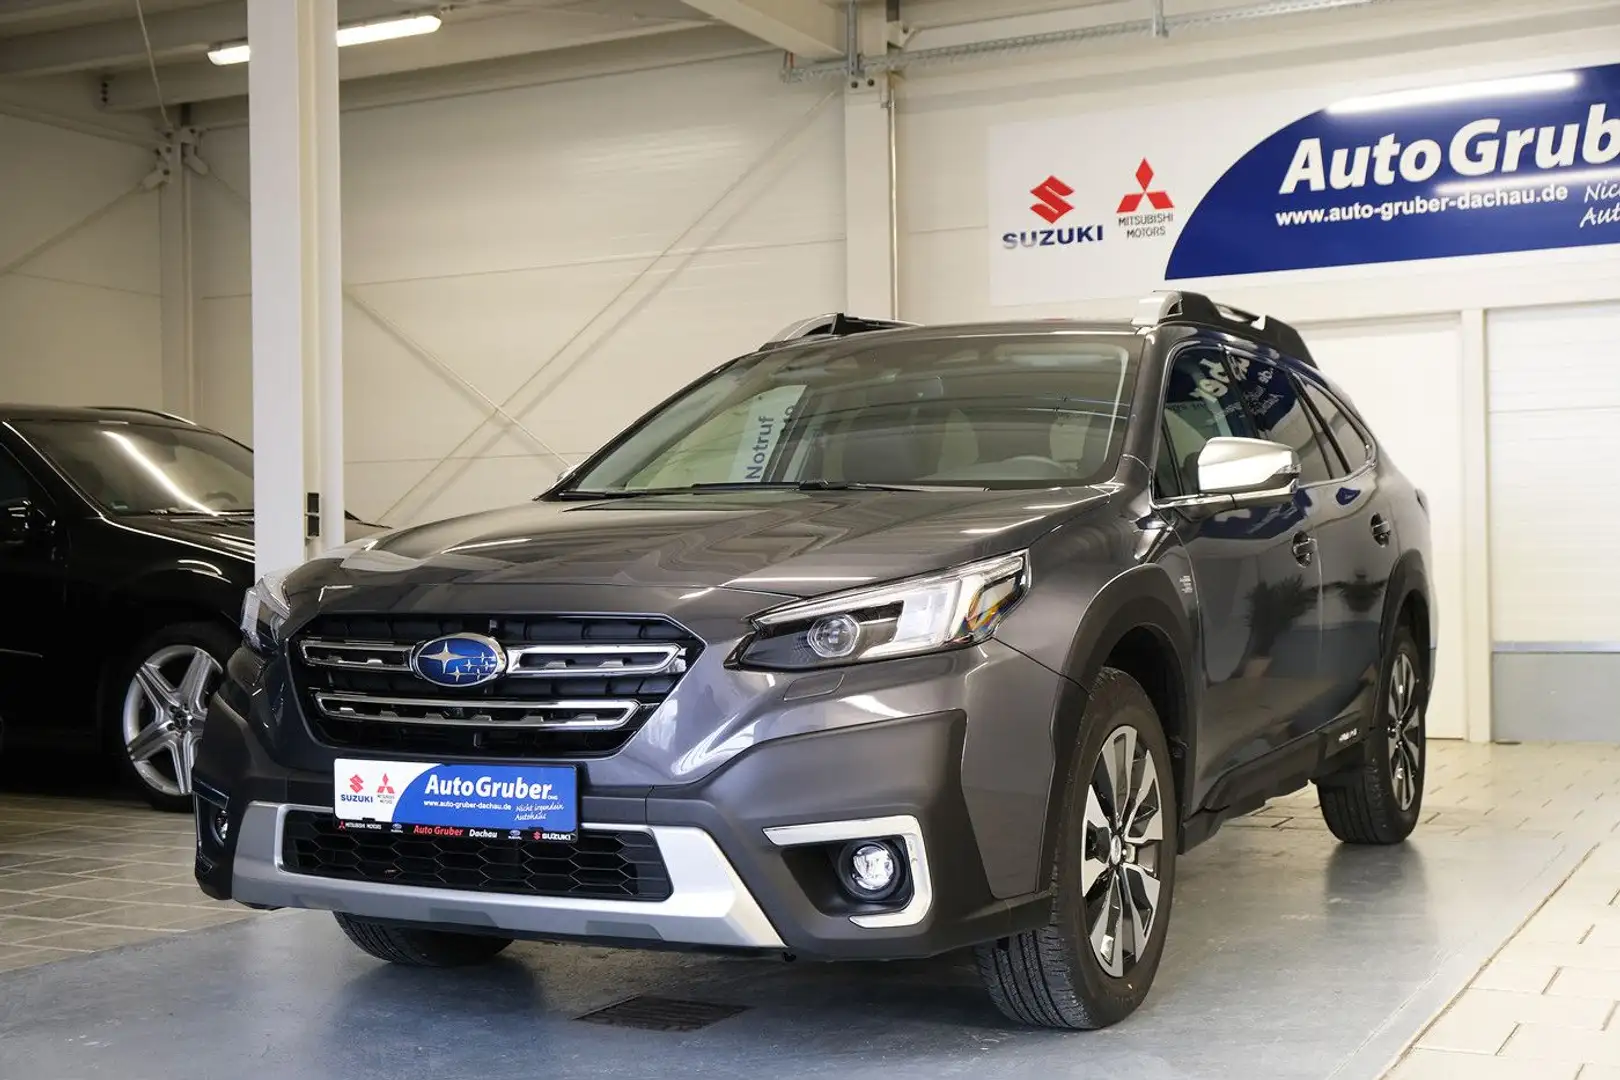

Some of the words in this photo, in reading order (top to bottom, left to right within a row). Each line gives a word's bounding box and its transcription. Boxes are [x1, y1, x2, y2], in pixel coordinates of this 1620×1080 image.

[1584, 179, 1620, 204] Nic
[1275, 183, 1568, 227] www.auto-gruber-dachau.de
[1118, 212, 1174, 226] MITSUBISHI
[1002, 224, 1103, 250] SUZUKI
[1126, 225, 1167, 239] MOTORS
[745, 415, 775, 480] Notruf
[341, 794, 373, 804] SUZUKI
[423, 800, 512, 811] www.auto-gruber-dachau.de
[413, 824, 433, 835] Auto
[434, 826, 464, 837] Gruber
[469, 828, 499, 839] Dachau
[542, 832, 571, 841] SUZUKI
